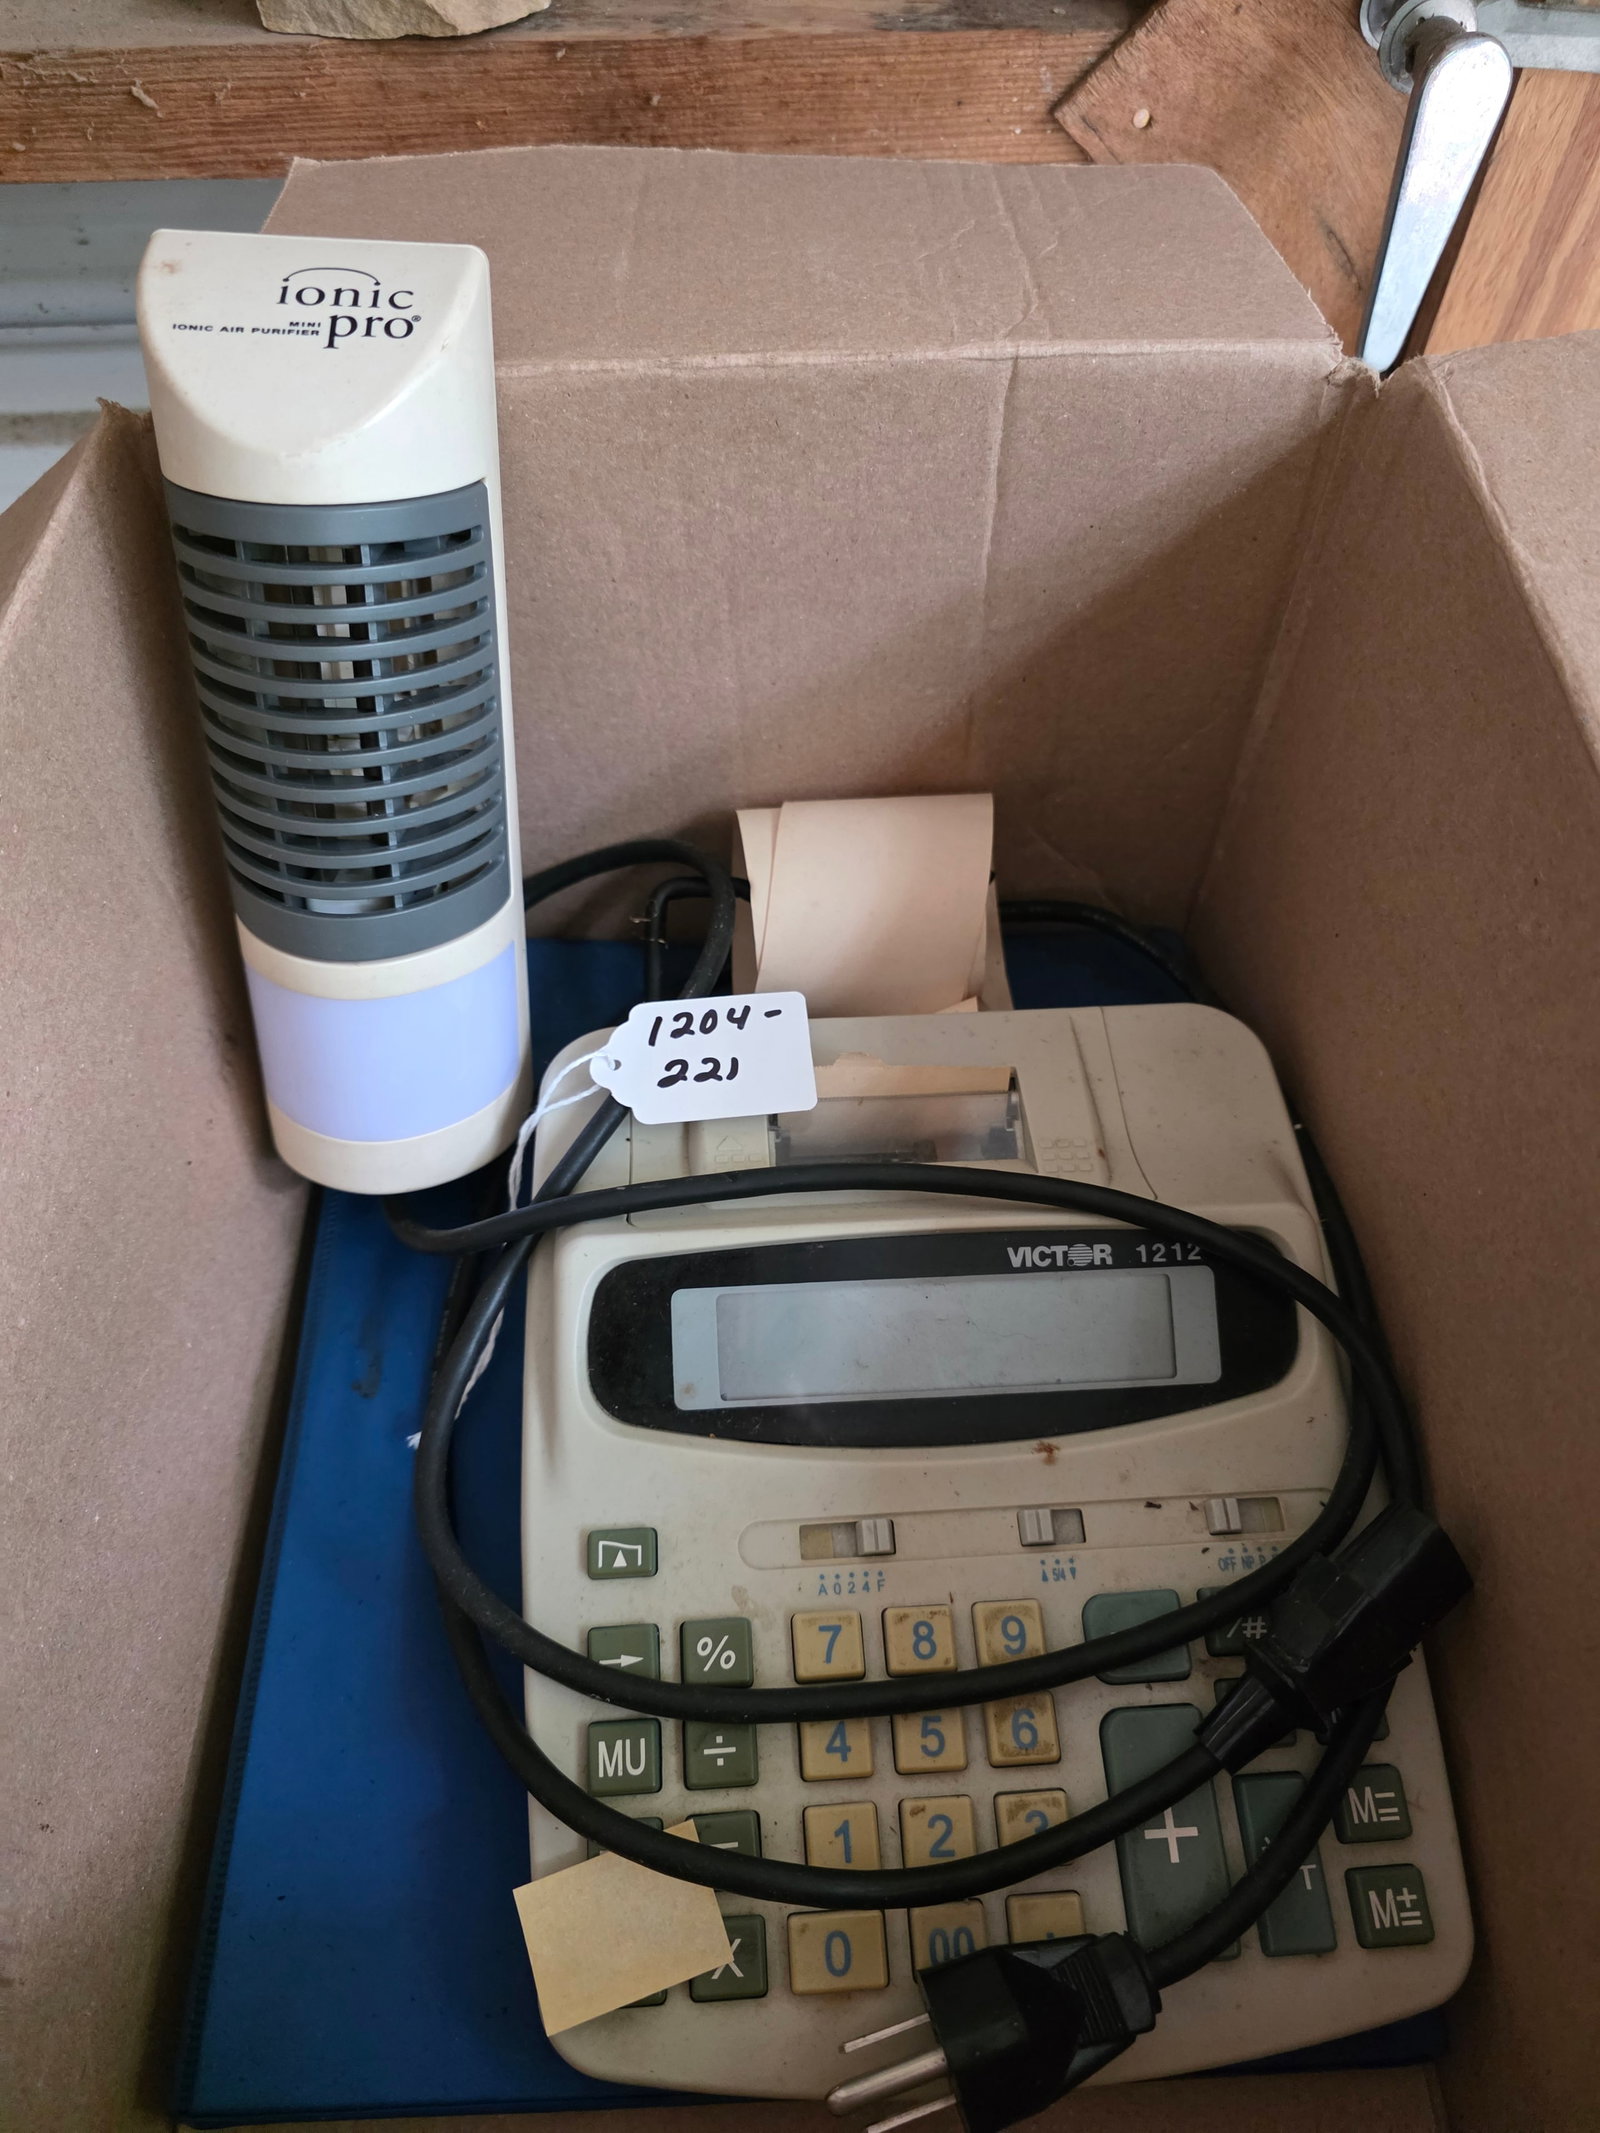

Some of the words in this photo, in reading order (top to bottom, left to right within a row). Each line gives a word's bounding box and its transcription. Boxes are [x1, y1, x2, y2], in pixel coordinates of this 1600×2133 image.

[276, 277, 414, 309] ionic
[172, 323, 214, 332] IONIC
[219, 325, 245, 333] AIR
[251, 327, 320, 336] PURIFIER
[289, 320, 321, 328] MINI
[657, 1057, 739, 1088] 221
[1007, 1243, 1113, 1268] VICTOR
[1136, 1242, 1202, 1263] 1212
[818, 1625, 842, 1664] 7
[912, 1620, 938, 1660] 8
[1001, 1616, 1027, 1655] 9
[825, 1720, 851, 1763] 4
[920, 1715, 945, 1758] 5
[1011, 1708, 1038, 1750] 6
[598, 1737, 646, 1779] MU
[834, 1819, 851, 1863] 1
[927, 1813, 955, 1858] 2
[824, 1930, 851, 1977] 0
